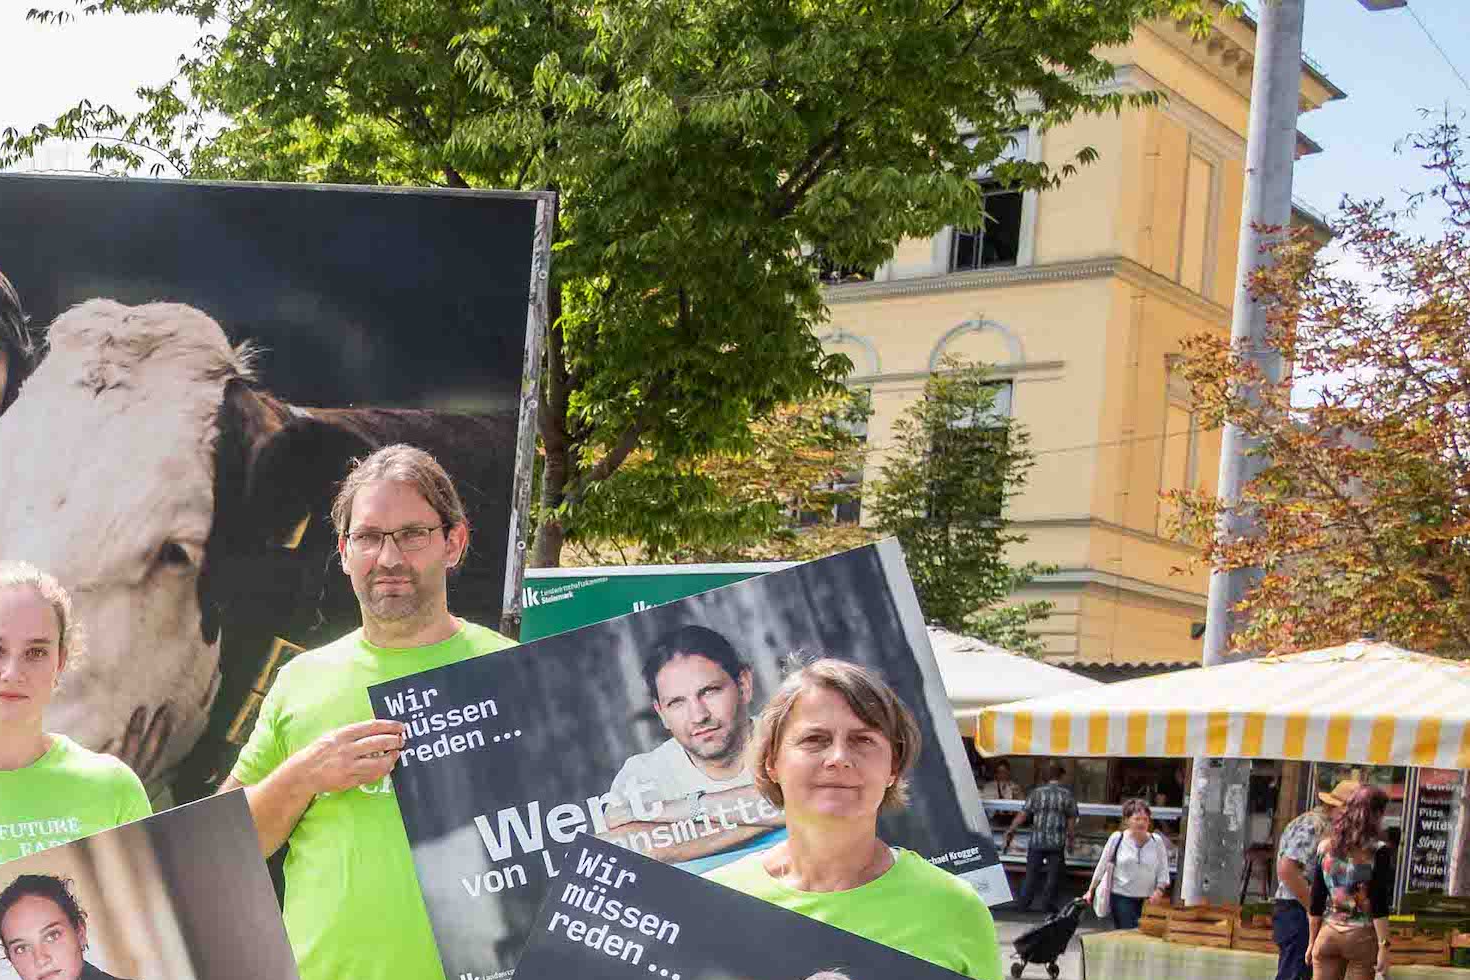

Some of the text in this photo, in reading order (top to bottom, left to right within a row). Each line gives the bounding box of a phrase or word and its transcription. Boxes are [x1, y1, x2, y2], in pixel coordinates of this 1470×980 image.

[522, 587, 540, 608] lk
[541, 592, 574, 604] Steiermark
[384, 688, 439, 717] Wir
[400, 728, 486, 767] reden
[474, 774, 665, 862] Wert
[576, 847, 637, 889] Wir
[949, 846, 979, 861] Krogger
[462, 863, 528, 898] von
[561, 881, 681, 945] müssen
[547, 911, 645, 966] reden
